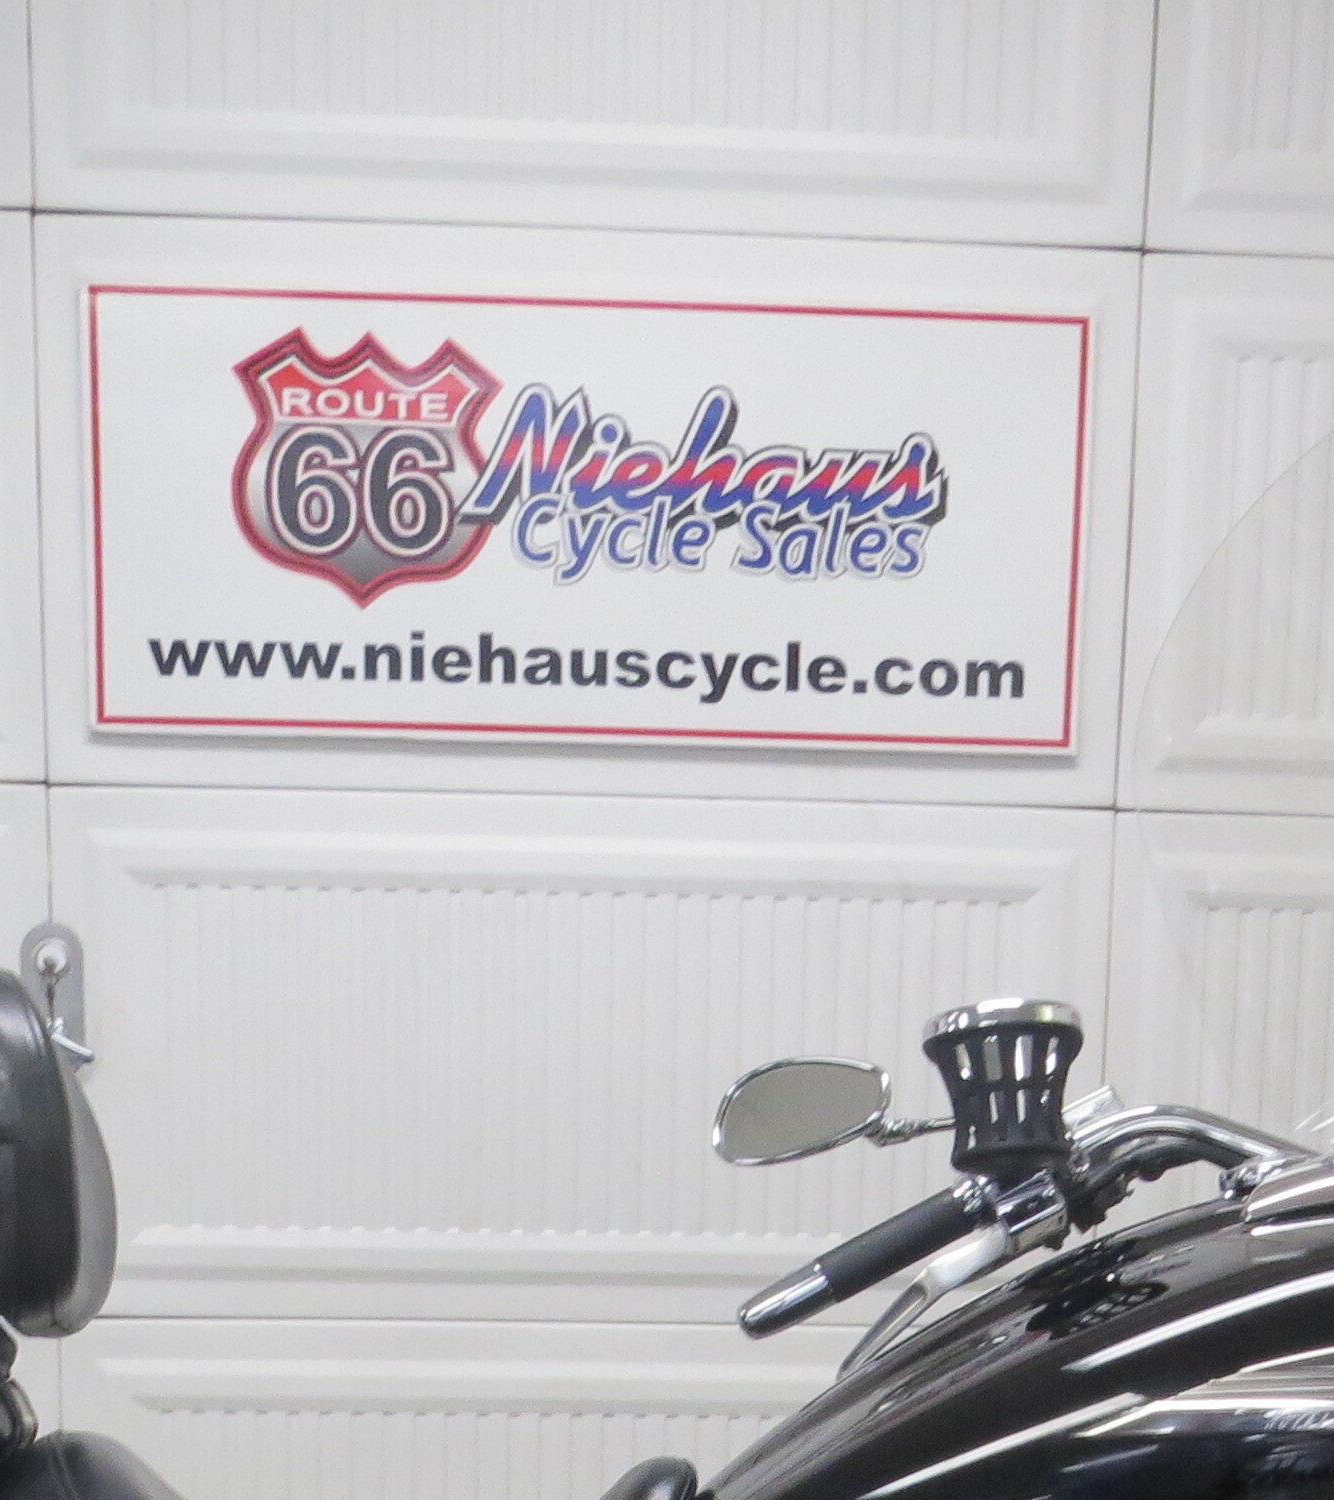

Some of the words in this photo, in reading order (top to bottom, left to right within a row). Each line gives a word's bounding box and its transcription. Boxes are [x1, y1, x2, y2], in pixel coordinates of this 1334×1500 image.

[281, 386, 449, 421] ROUTE
[269, 427, 452, 556] 66
[464, 383, 946, 521] Niehaus
[515, 494, 713, 580] Cycle
[733, 503, 931, 578] Sales
[148, 630, 1026, 704] www.niehauscycle.com
